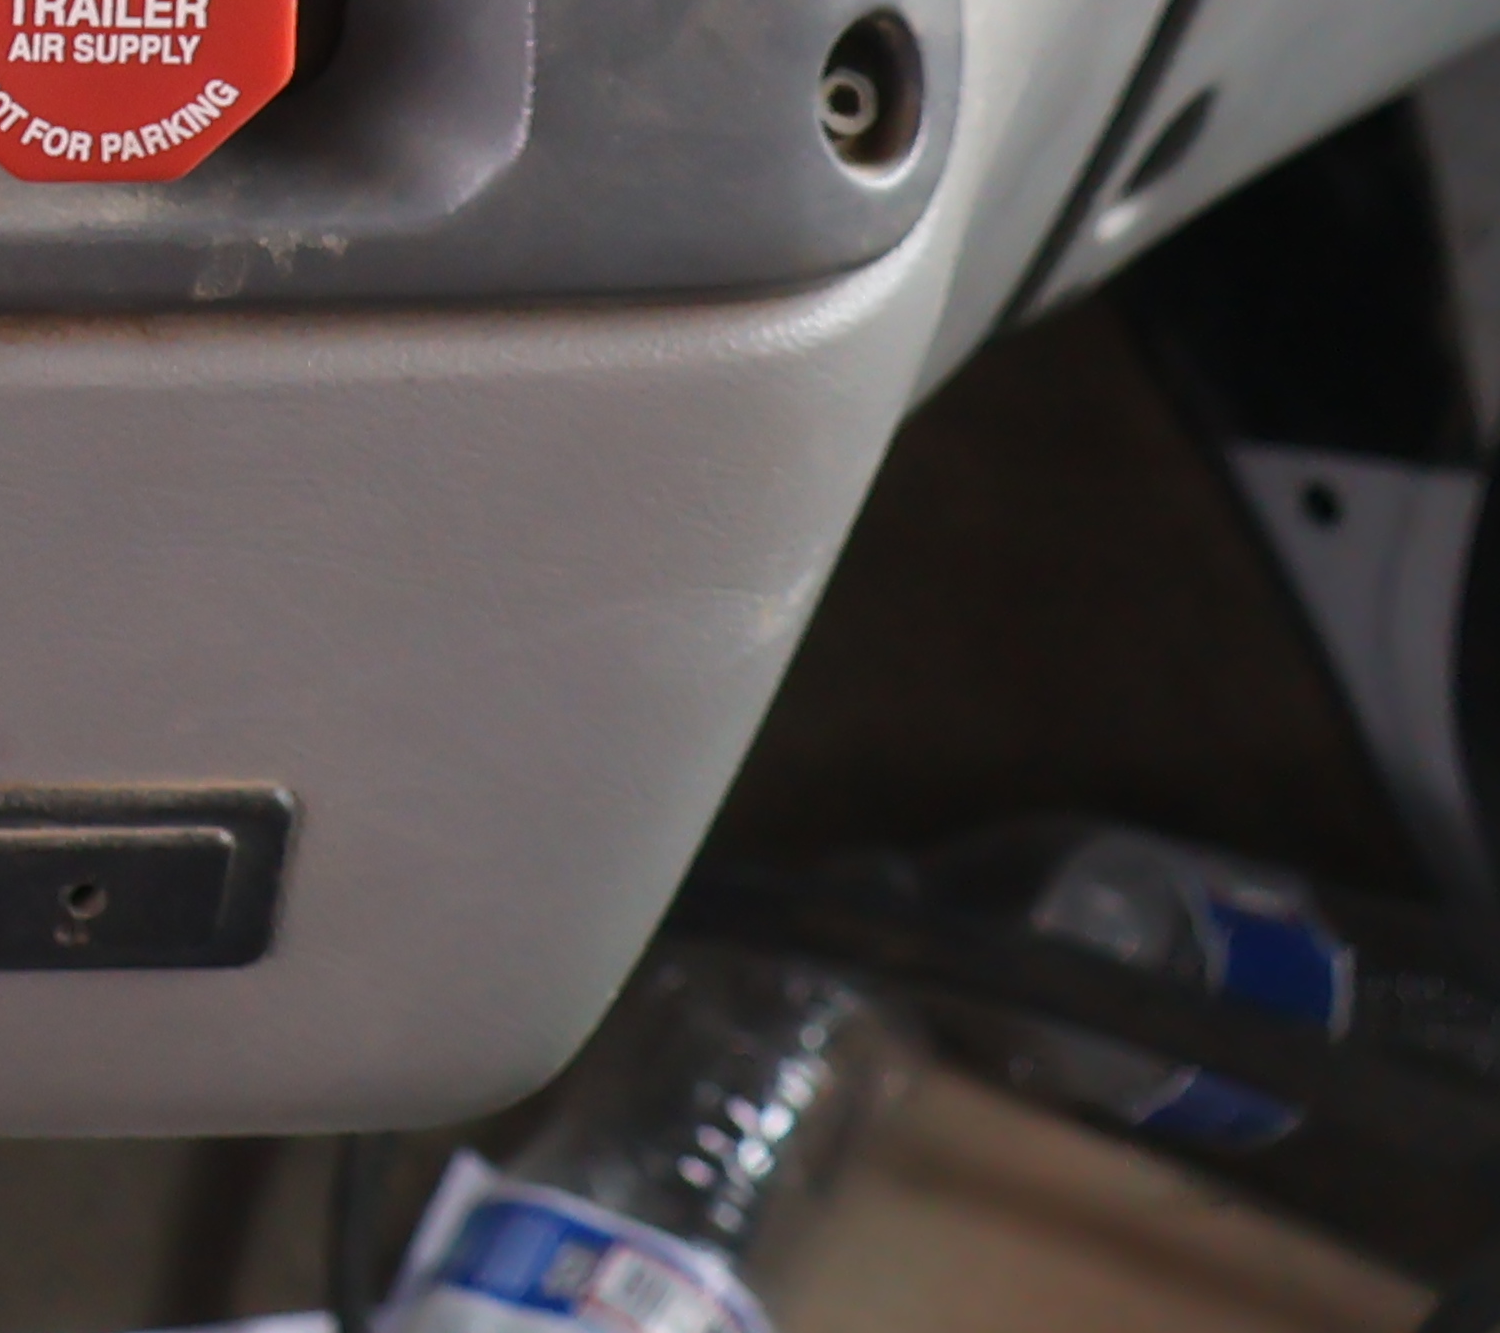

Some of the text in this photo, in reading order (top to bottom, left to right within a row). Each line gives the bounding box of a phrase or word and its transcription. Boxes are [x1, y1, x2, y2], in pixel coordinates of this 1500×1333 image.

[8, 33, 201, 65] AIR SUPPLY
[21, 117, 91, 162] FOR
[100, 78, 241, 163] PARKING
